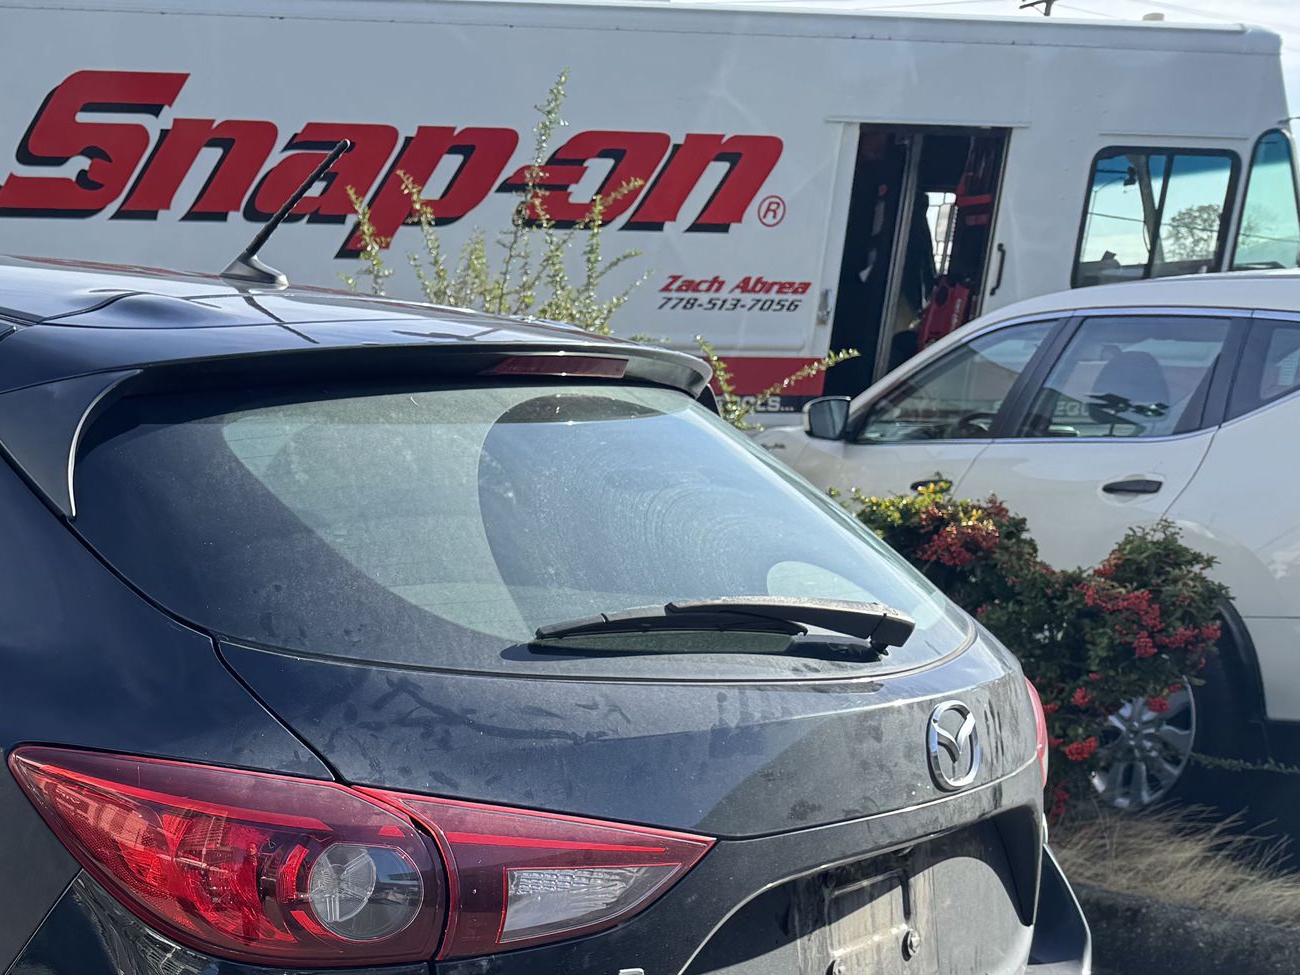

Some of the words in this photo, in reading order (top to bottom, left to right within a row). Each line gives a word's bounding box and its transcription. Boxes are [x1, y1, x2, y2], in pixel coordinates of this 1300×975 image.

[658, 275, 727, 293] Zach
[729, 275, 813, 296] Abrea
[658, 297, 803, 313] 778-513-7056
